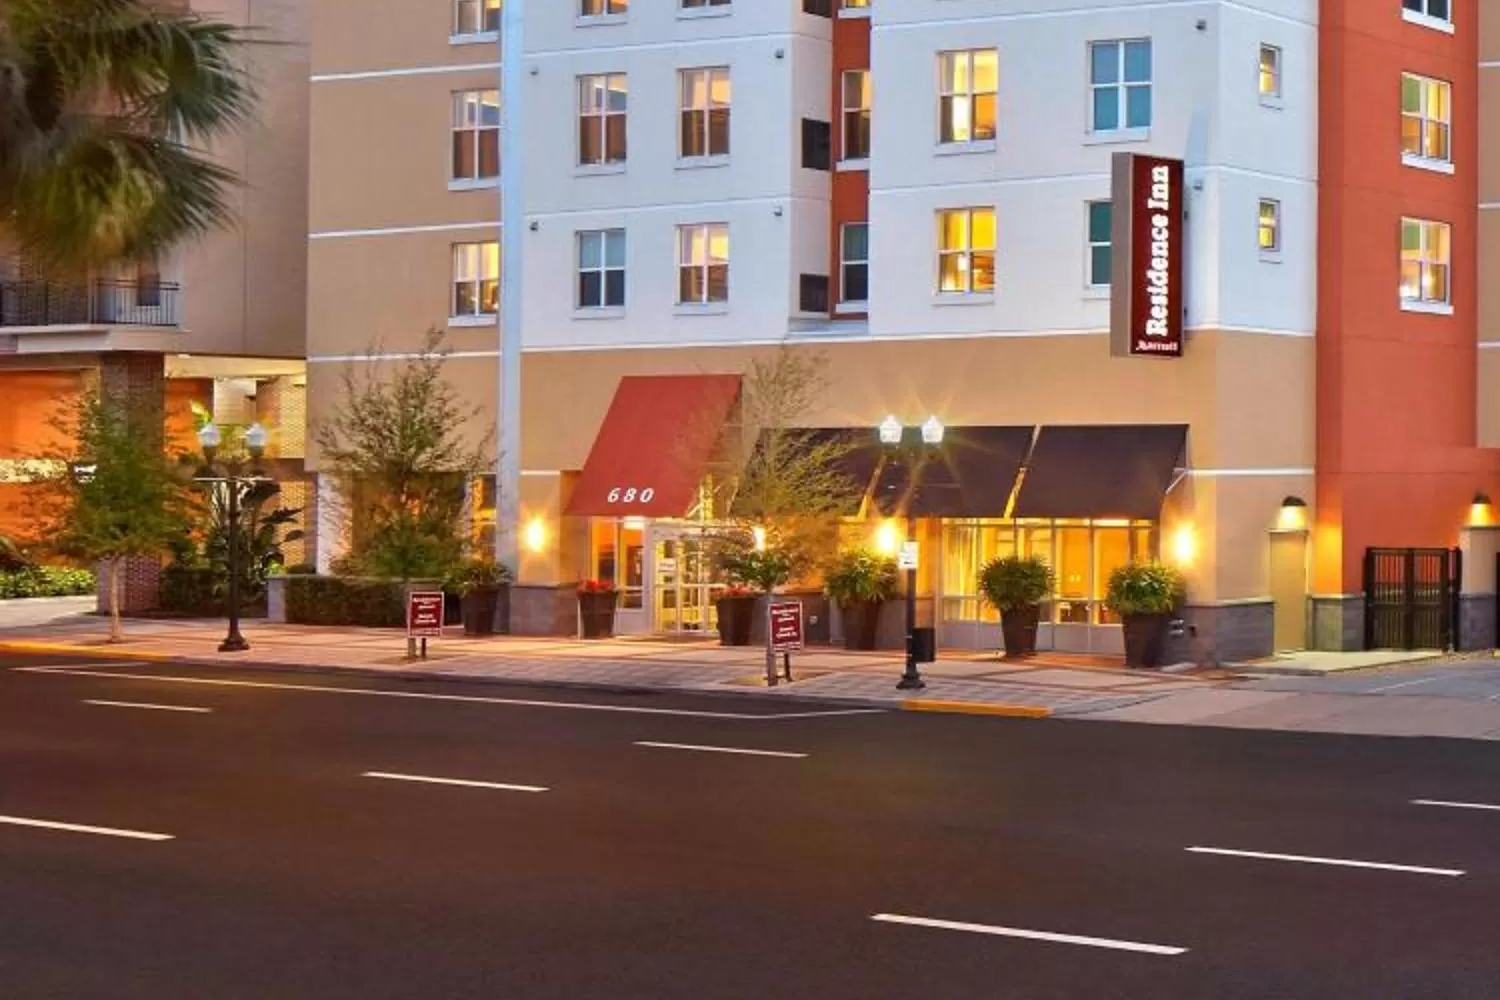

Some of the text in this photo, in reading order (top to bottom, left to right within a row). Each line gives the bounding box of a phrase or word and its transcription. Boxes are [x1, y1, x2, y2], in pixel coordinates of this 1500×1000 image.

[1146, 165, 1169, 337] Residence Inn
[607, 487, 655, 503] 680
